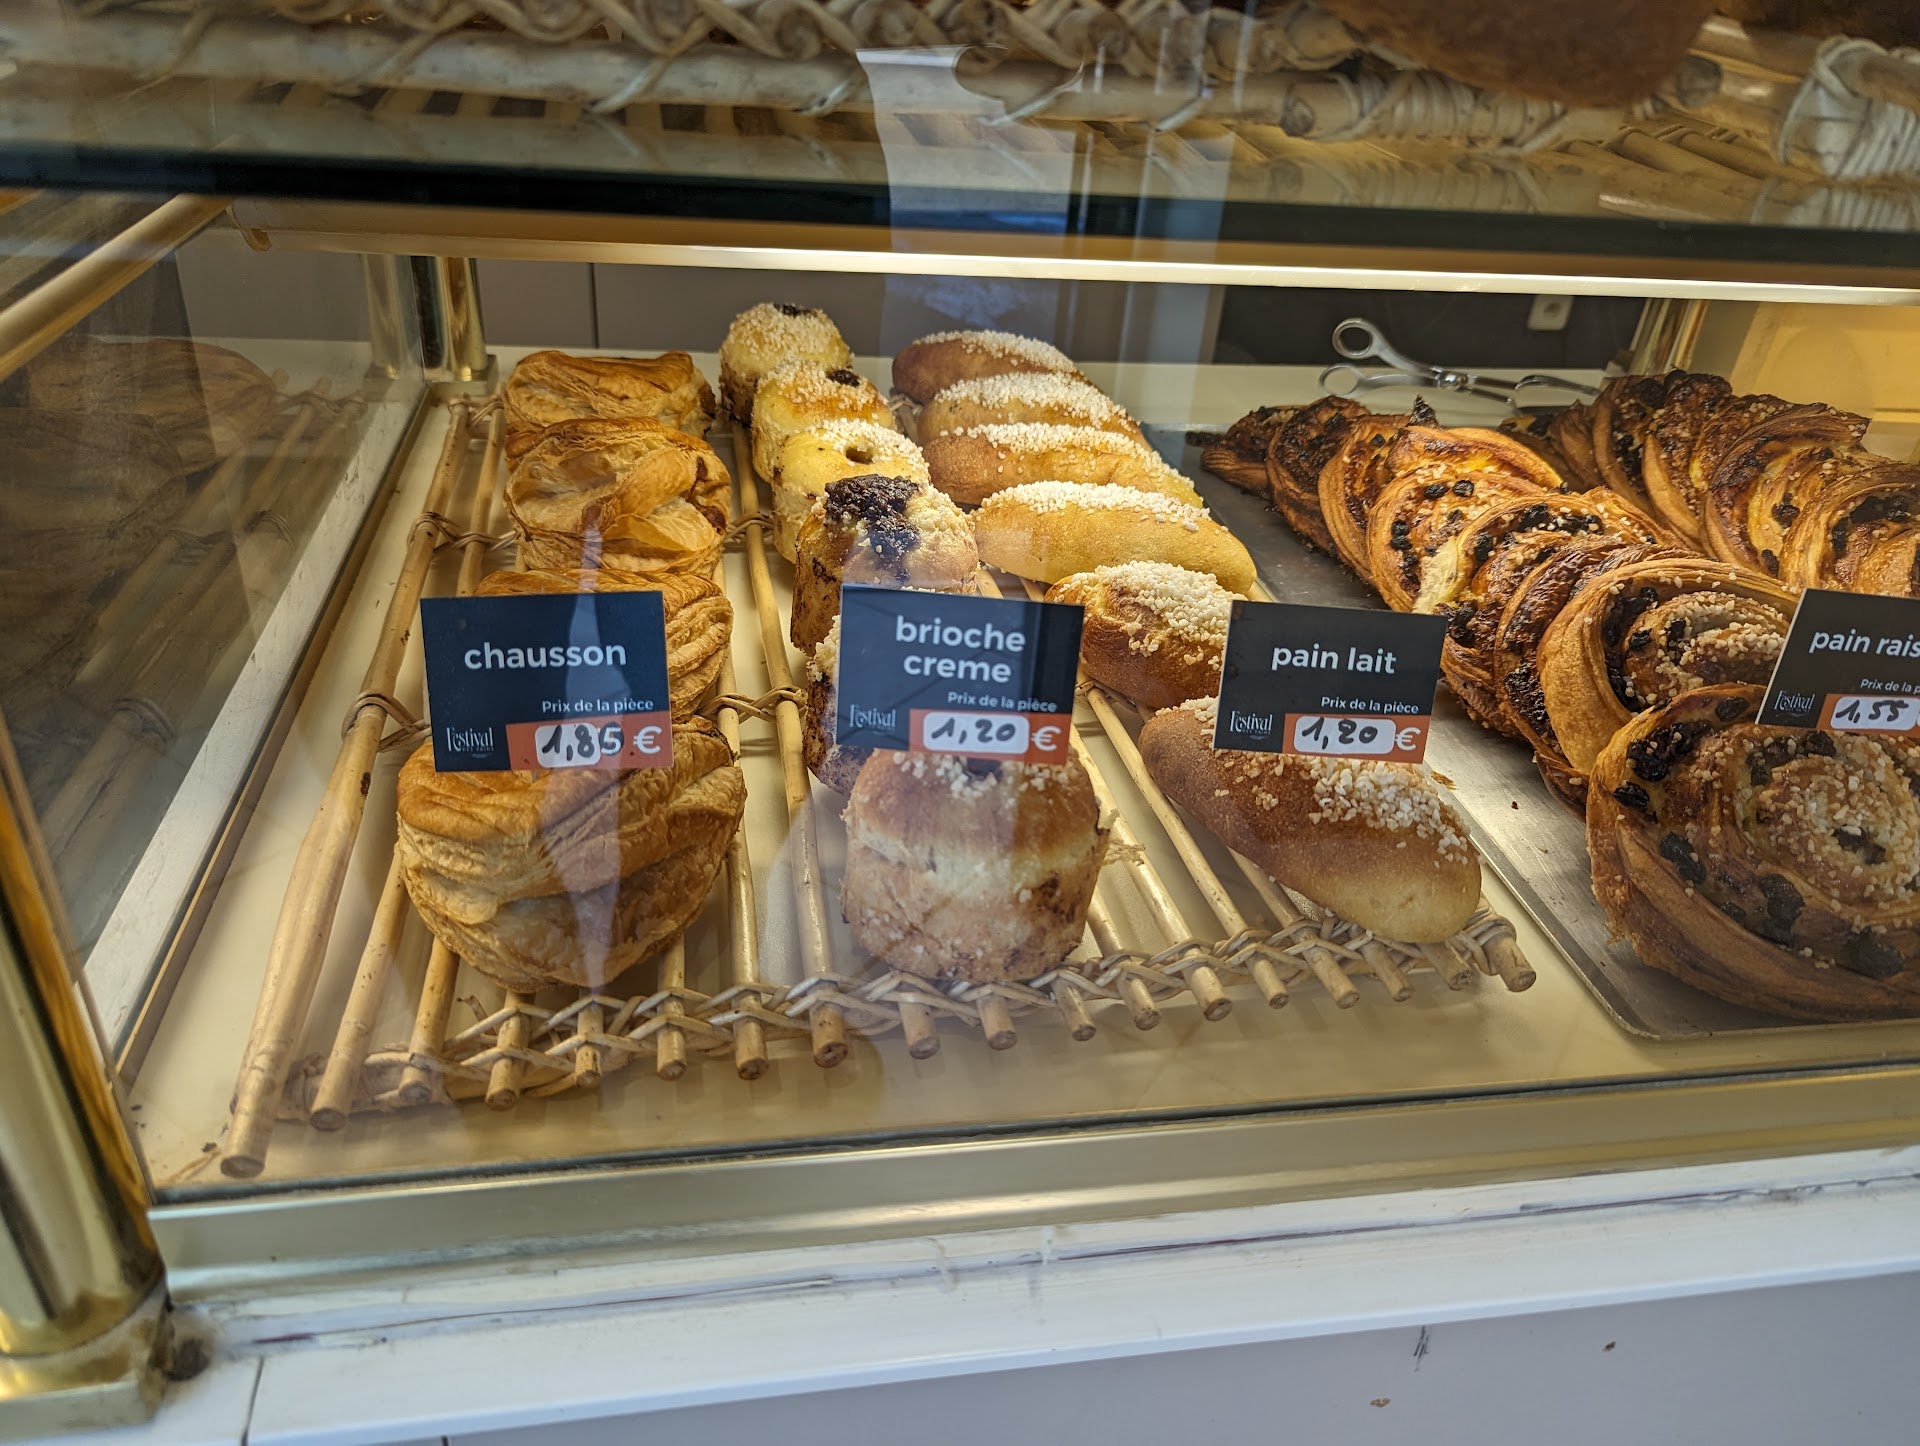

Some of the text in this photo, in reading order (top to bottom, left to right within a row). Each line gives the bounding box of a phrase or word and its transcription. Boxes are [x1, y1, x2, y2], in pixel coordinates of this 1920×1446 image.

[896, 615, 1026, 652] brioche
[1809, 628, 1871, 654] pain
[464, 642, 626, 670] chausson
[903, 654, 1012, 683] creme
[1271, 643, 1397, 674] pain lait
[1860, 679, 1882, 689] Prix
[1885, 681, 1900, 692] de
[1902, 682, 1912, 693] la
[542, 697, 654, 714] Prix de la pièce
[947, 691, 1058, 713] Prix de la pièce
[1321, 696, 1420, 714] Prix de la pièce
[1835, 700, 1910, 724] 1,55
[633, 726, 663, 754] €
[931, 717, 1062, 751] 1,20 €
[1302, 716, 1421, 751] 1,20 €
